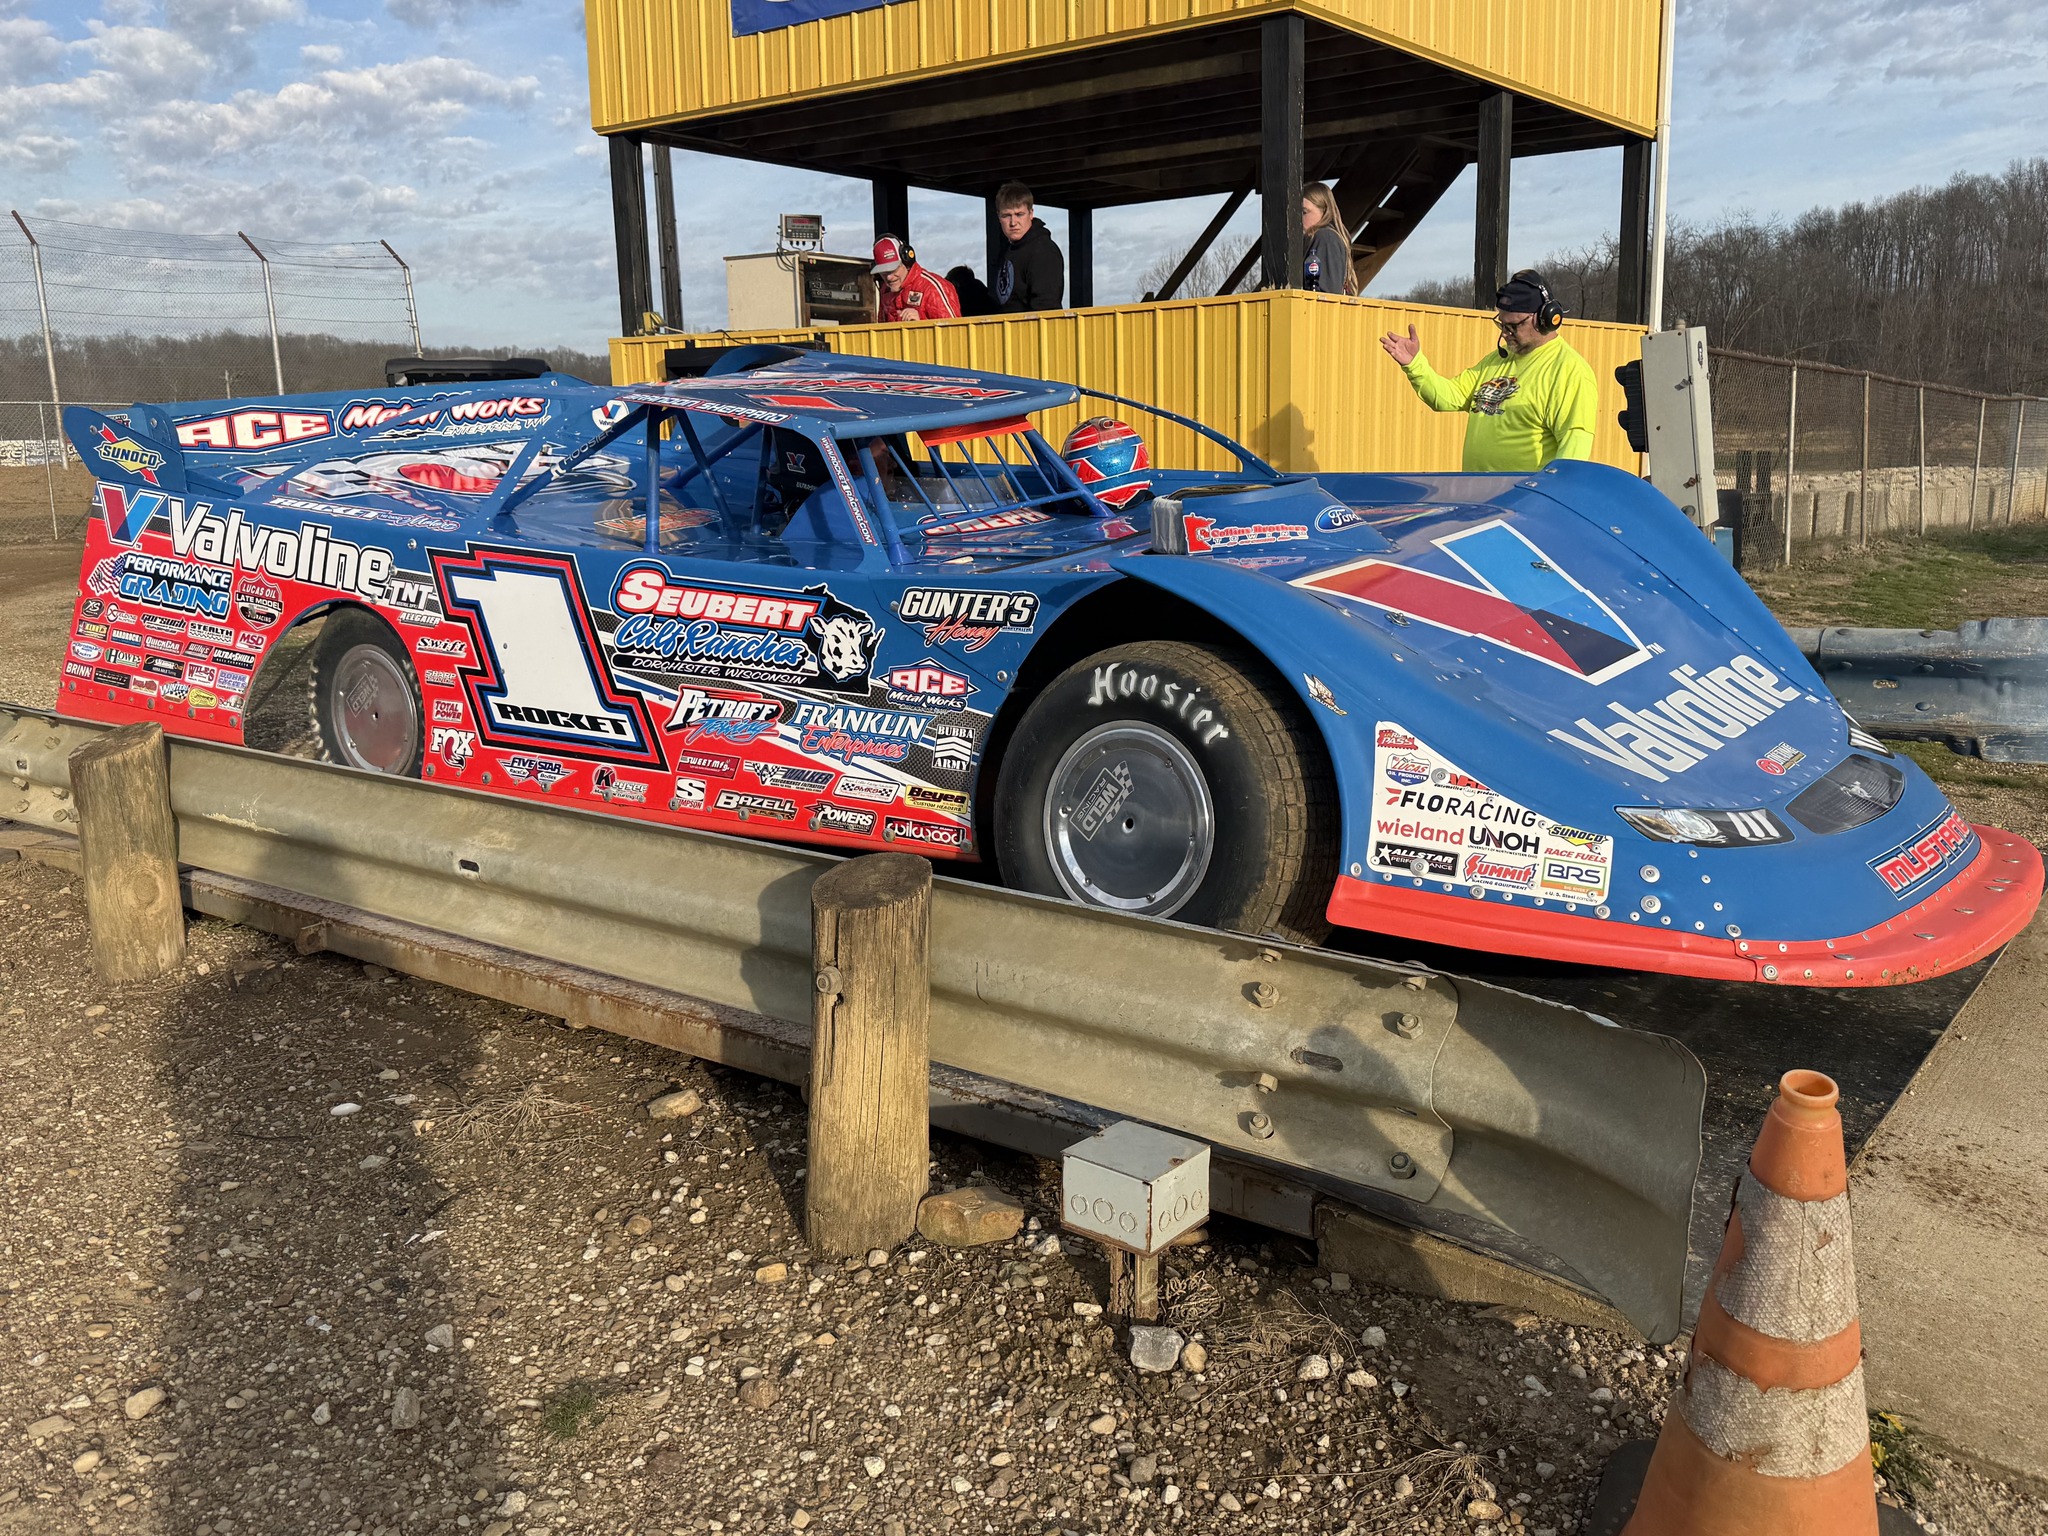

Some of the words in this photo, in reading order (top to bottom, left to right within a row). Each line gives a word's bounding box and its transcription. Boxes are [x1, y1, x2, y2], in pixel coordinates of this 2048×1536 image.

[452, 397, 545, 420] Works
[625, 393, 697, 408] BRANDON
[697, 401, 790, 423] SHEPPARD
[176, 411, 331, 448] ACE
[102, 444, 157, 467] SUNOCO
[564, 427, 614, 465] HOOSIER
[1211, 525, 1251, 538] Collins
[1253, 523, 1307, 534] Brothers
[169, 497, 392, 598] Valvoline
[124, 555, 231, 589] PERFORMANCE
[120, 573, 230, 616] GRADING
[235, 593, 255, 603] LATE
[255, 598, 282, 611] MODEL
[241, 582, 264, 596] LUCAS
[265, 588, 277, 599] OIL
[389, 579, 434, 610] TNT
[617, 570, 819, 631] SEUBERT
[399, 611, 441, 625] ALLGAIER
[901, 590, 1035, 622] GUNTER'S
[190, 621, 233, 637] STEALTH
[239, 632, 265, 646] MSD
[615, 616, 684, 660] Calf
[682, 619, 805, 665] Ranches
[926, 613, 1001, 651] Honey
[452, 570, 637, 743] 1
[65, 662, 92, 678] BRINN
[632, 657, 721, 677] DORCHESTER,
[724, 668, 807, 685] WISCONSIN
[891, 667, 967, 697] ACE
[435, 700, 459, 712] TOTAL
[666, 688, 780, 729] PETROFF
[888, 691, 925, 703] Metal
[926, 695, 964, 709] Works
[1087, 662, 1230, 745] Hoosier
[435, 709, 462, 720] POWER
[492, 701, 629, 736] ROCKET
[795, 704, 928, 741] FRANKLIN
[1548, 654, 1802, 783] Valvoline
[688, 716, 776, 744] Towing
[938, 726, 973, 739] BUBBA
[430, 727, 476, 764] FOX
[801, 724, 907, 763] Enterprises
[510, 756, 536, 769] FIVE
[538, 760, 562, 773] STAR
[782, 767, 835, 786] WALKER
[934, 758, 969, 771] ARMY
[1391, 761, 1429, 774] LUCAS
[1398, 772, 1428, 781] PRODUCTS
[678, 799, 703, 809] IMPSON
[716, 791, 797, 813] BAZELL
[908, 786, 967, 804] Beyea
[913, 800, 936, 809] CUSTOM
[937, 804, 962, 812] HEADERS
[1076, 777, 1107, 822] RACING
[817, 803, 875, 826] POWERS
[1082, 783, 1120, 832] WELD
[1400, 789, 1537, 828] FLORACING
[886, 820, 964, 846] wilwood
[1376, 818, 1464, 846] wieland
[1469, 824, 1540, 855] UNOH
[1551, 826, 1603, 843] SUNOCO
[1390, 856, 1453, 871] PERFANCE
[1391, 848, 1455, 864] ALLSTAR
[1544, 847, 1573, 858] RACE
[1574, 852, 1607, 864] FUELS
[1874, 810, 1971, 893] MUSTANG
[1547, 863, 1601, 884] BRS
[1494, 882, 1528, 891] EQUIPMENT
